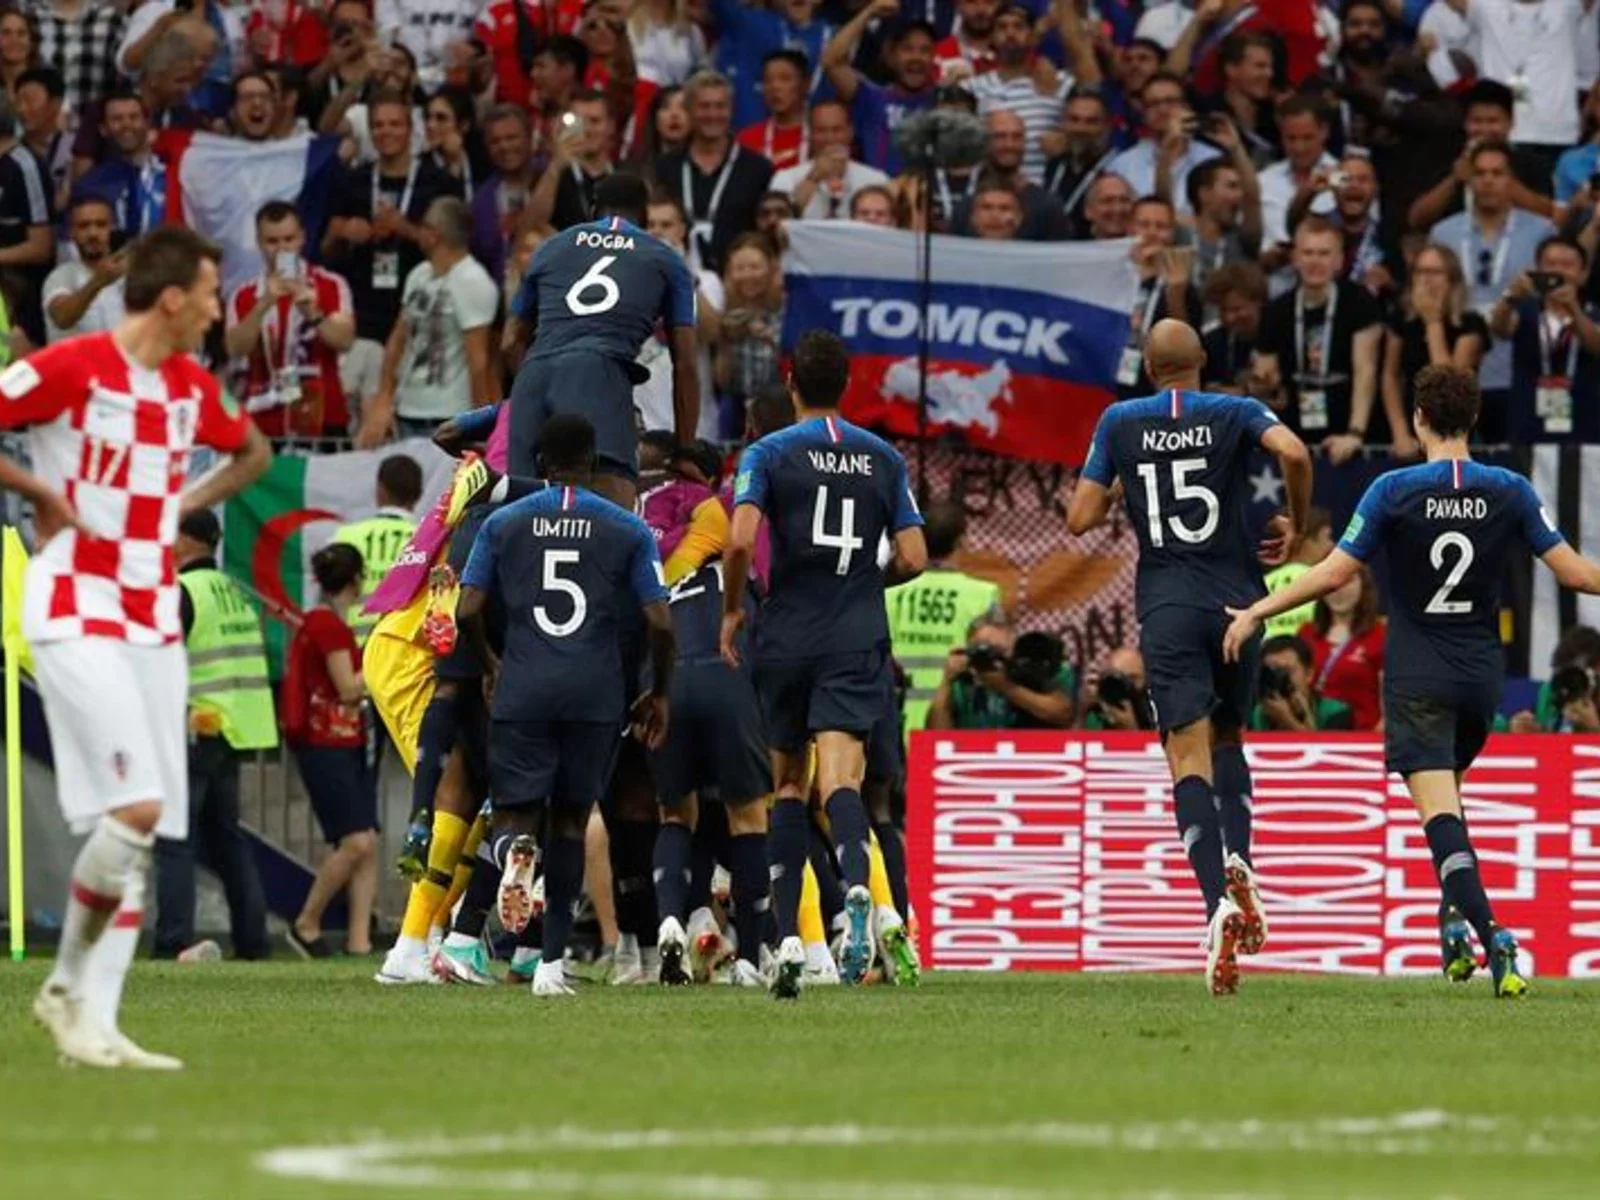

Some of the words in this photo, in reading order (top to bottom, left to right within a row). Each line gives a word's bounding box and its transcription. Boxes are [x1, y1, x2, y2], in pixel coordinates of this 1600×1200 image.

[575, 230, 635, 251] POGBA
[564, 255, 621, 317] 6
[830, 296, 1073, 366] ТОМСК
[86, 436, 128, 487] 17
[808, 450, 873, 477] VARANE
[1142, 425, 1213, 452] NZONZI
[532, 516, 592, 539] UMTITI
[811, 485, 864, 576] 4
[1137, 457, 1220, 549] 15
[1425, 496, 1488, 520] PAVARD
[532, 549, 588, 638] 5
[1424, 530, 1475, 614] 2
[895, 587, 959, 625] 11565
[930, 740, 1083, 971] ЧРЕЗМЕРНОЕ
